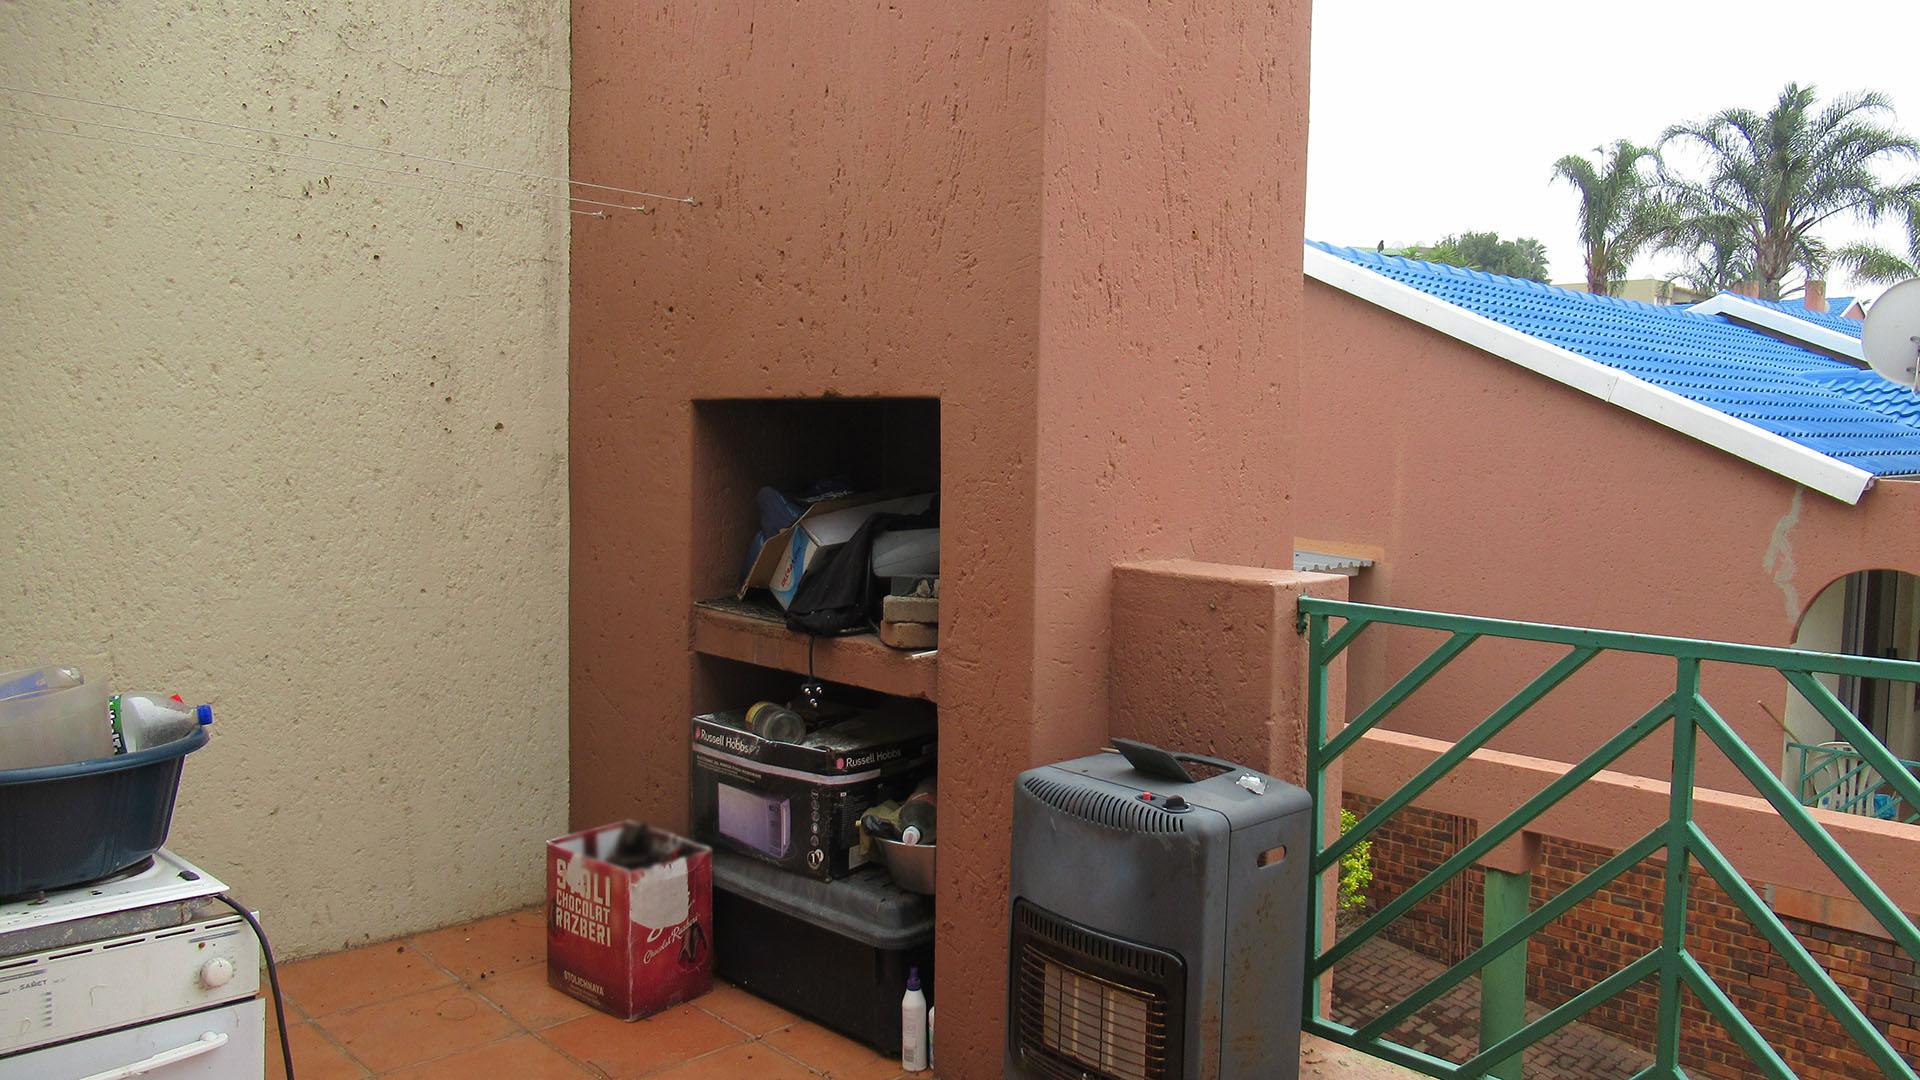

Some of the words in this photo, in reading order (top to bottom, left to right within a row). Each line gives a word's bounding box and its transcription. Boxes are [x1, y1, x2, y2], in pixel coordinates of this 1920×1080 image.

[701, 729, 725, 746] Russell
[725, 736, 749, 753] Hobbs
[846, 752, 876, 768] Russell
[556, 888, 611, 926] CHOCOLAT
[556, 906, 611, 947] RAZBERI
[563, 969, 605, 997] STOLICHNAYA
